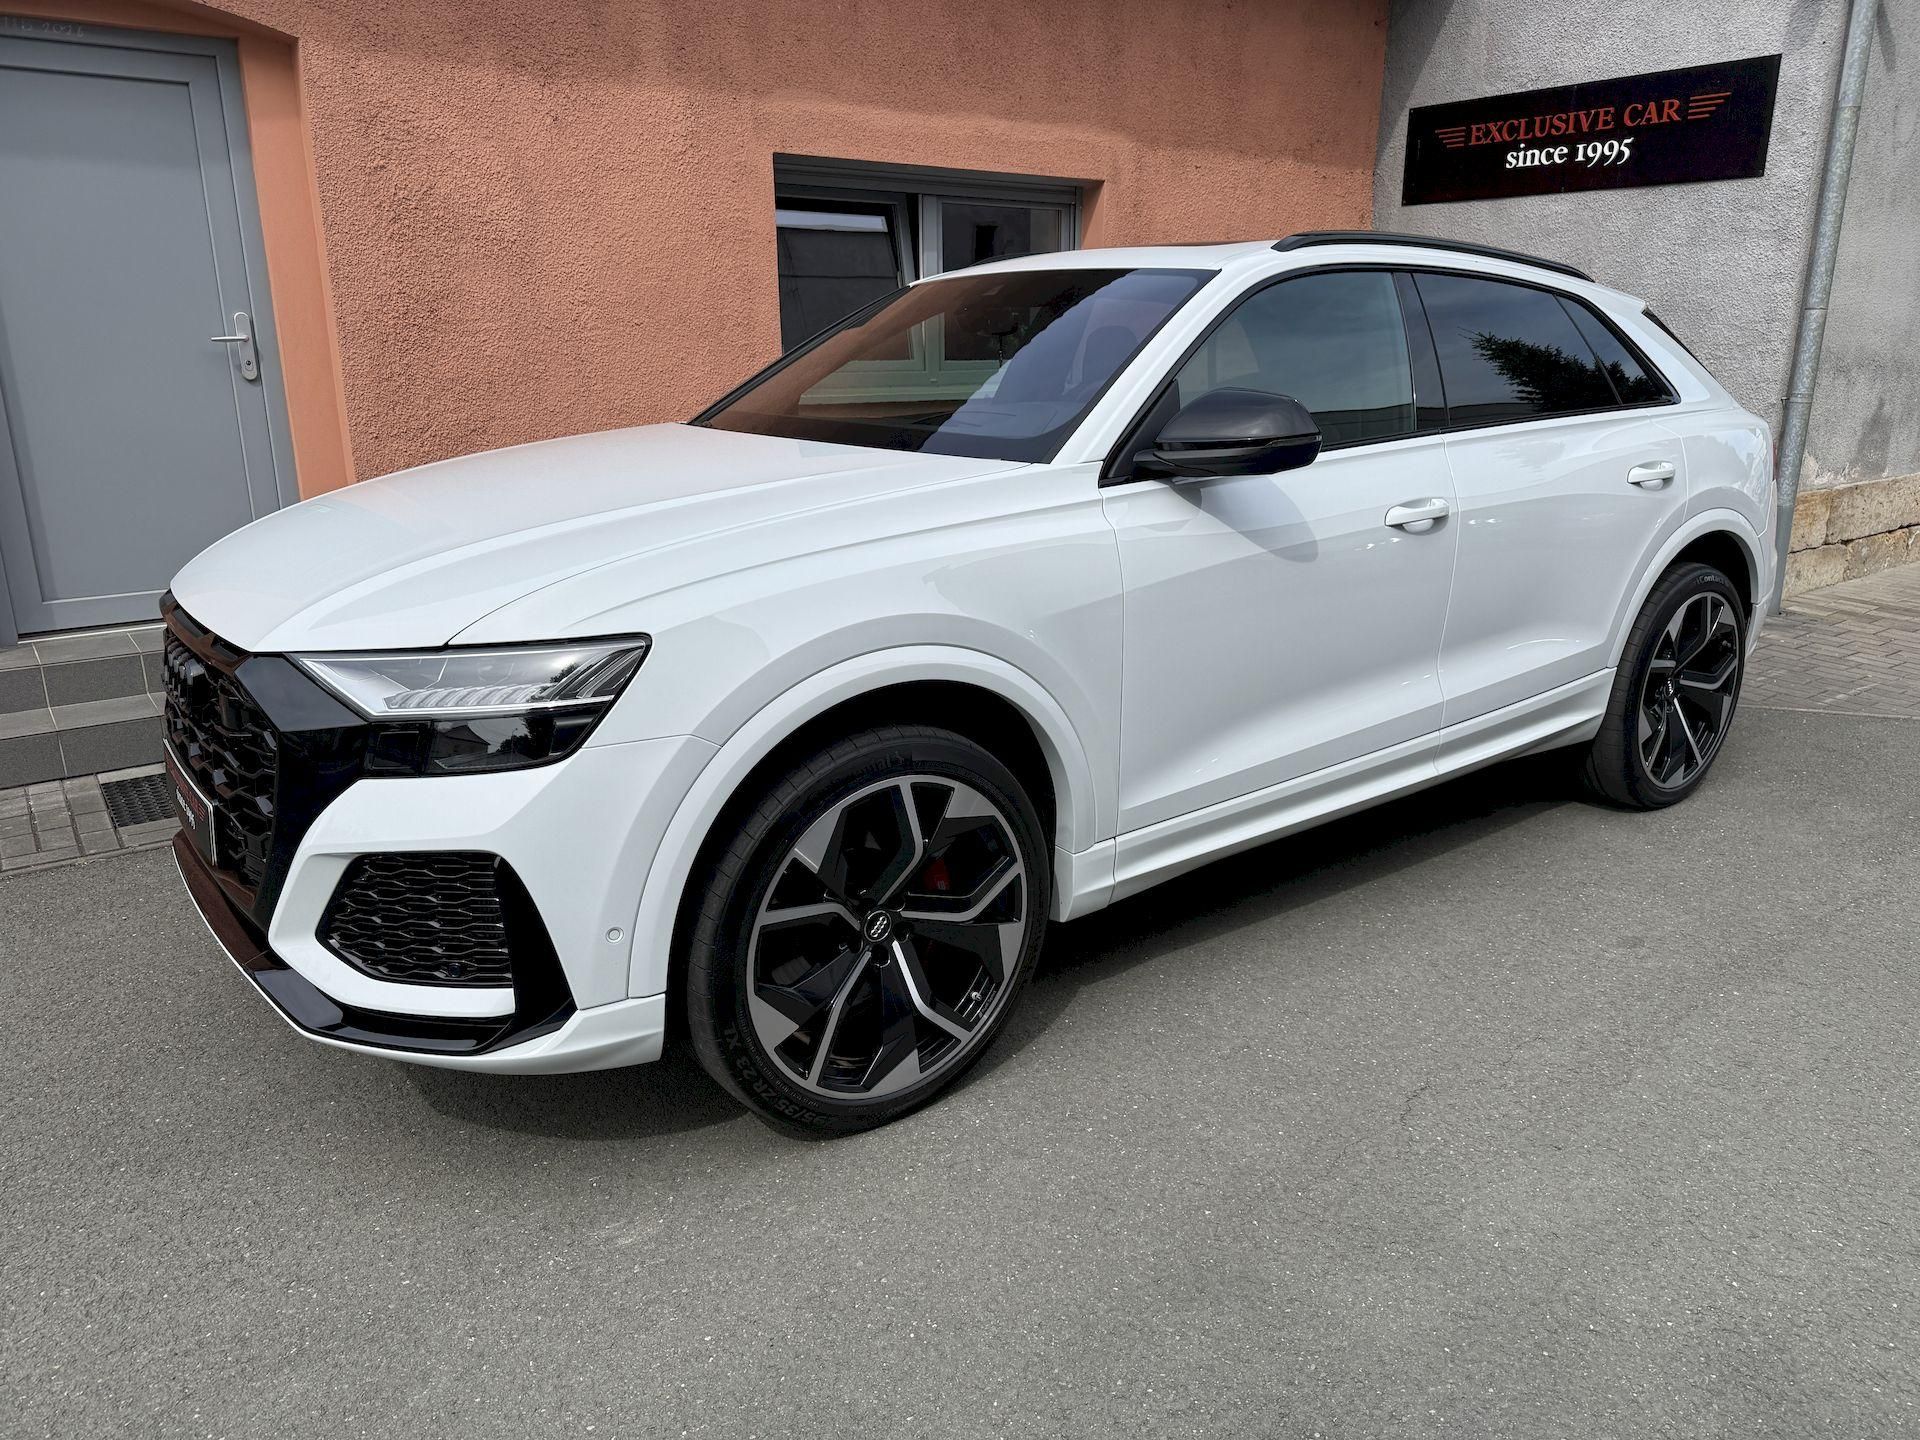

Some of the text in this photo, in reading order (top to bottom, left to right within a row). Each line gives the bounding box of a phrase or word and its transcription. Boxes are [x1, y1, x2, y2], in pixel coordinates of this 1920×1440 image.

[1469, 99, 1681, 145] EXCLUSIVE CAR
[1505, 137, 1634, 168] since 1995
